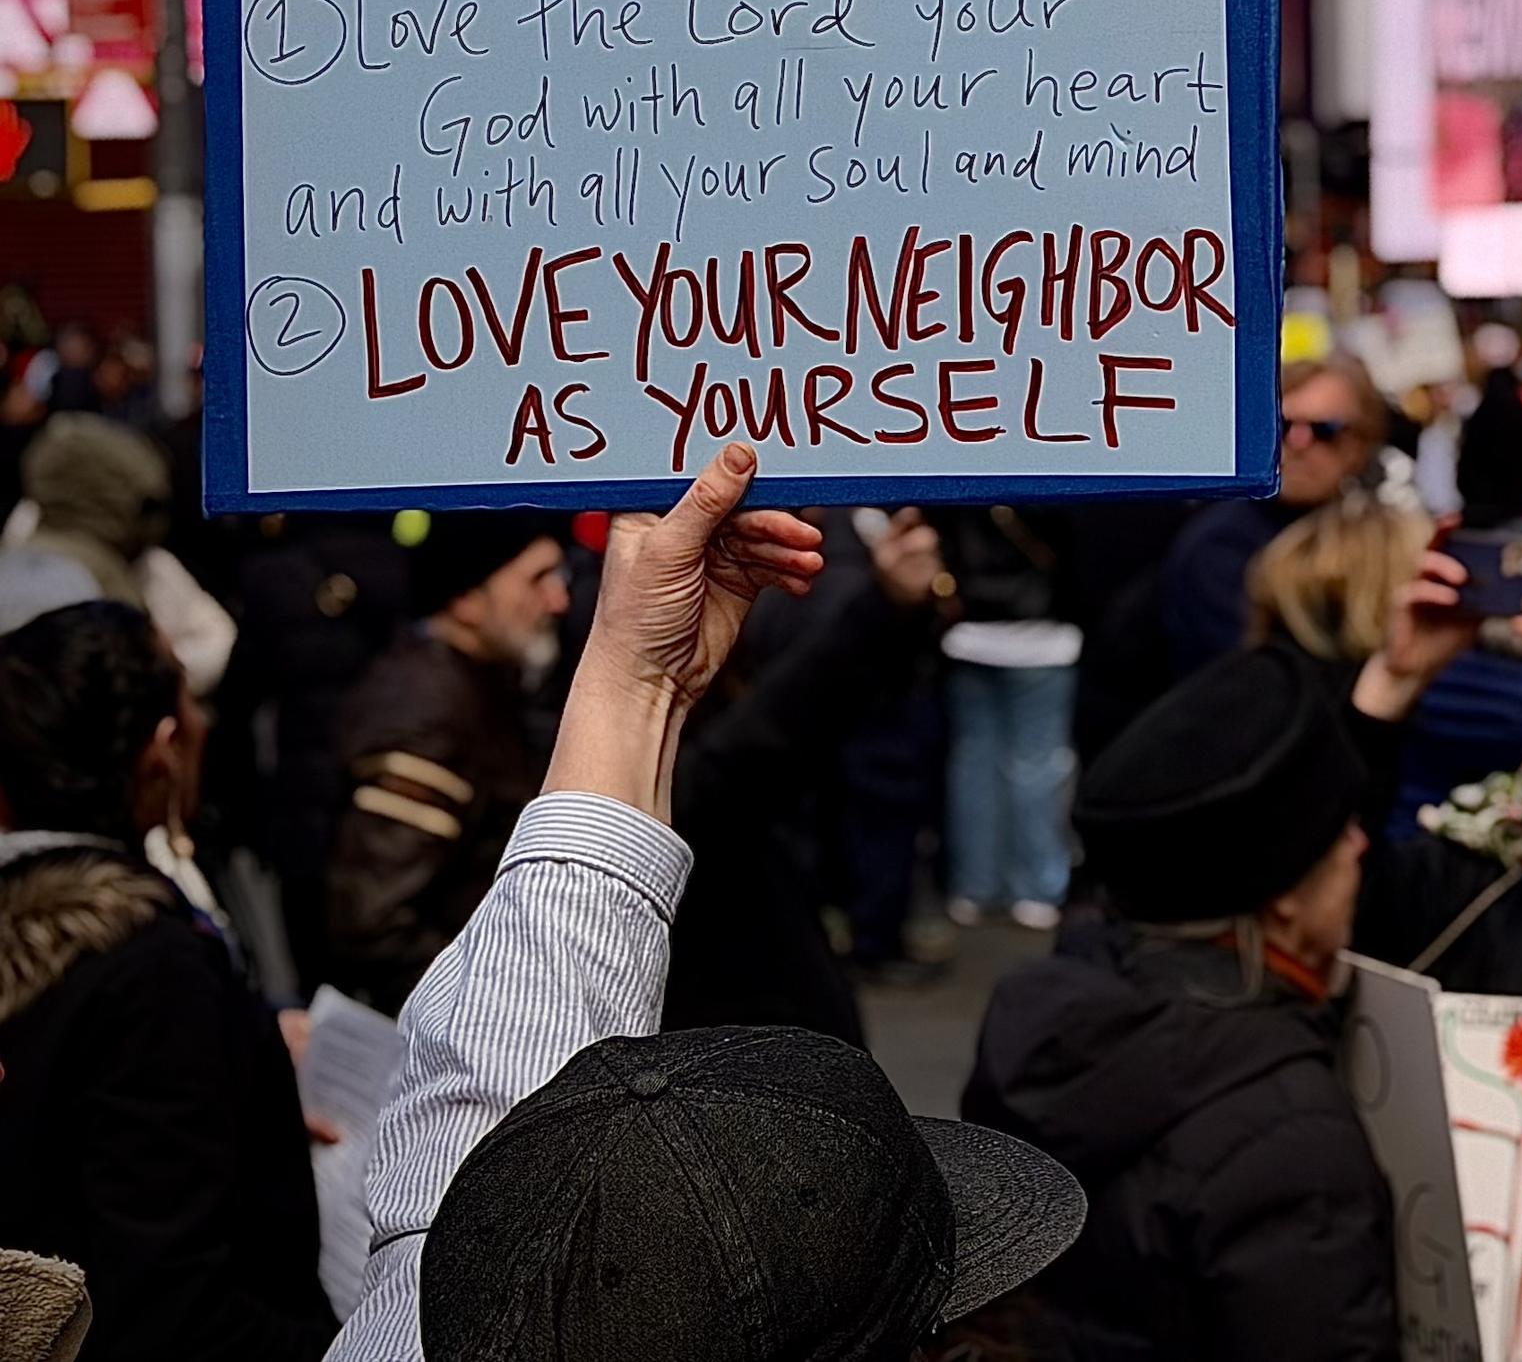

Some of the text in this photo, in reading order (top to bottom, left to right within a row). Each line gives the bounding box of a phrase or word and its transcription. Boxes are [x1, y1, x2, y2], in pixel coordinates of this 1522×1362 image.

[420, 48, 1224, 177] God with all your heart
[286, 164, 403, 244] and
[437, 156, 558, 228] with
[580, 147, 639, 226] all
[660, 154, 786, 243] your
[955, 130, 1045, 191] and
[1068, 125, 1198, 182] mind
[361, 246, 610, 400] LOVE
[612, 242, 841, 383] YOUR
[845, 223, 1239, 356] NEIGHBOR
[505, 353, 1176, 473] AS YOURSELF
